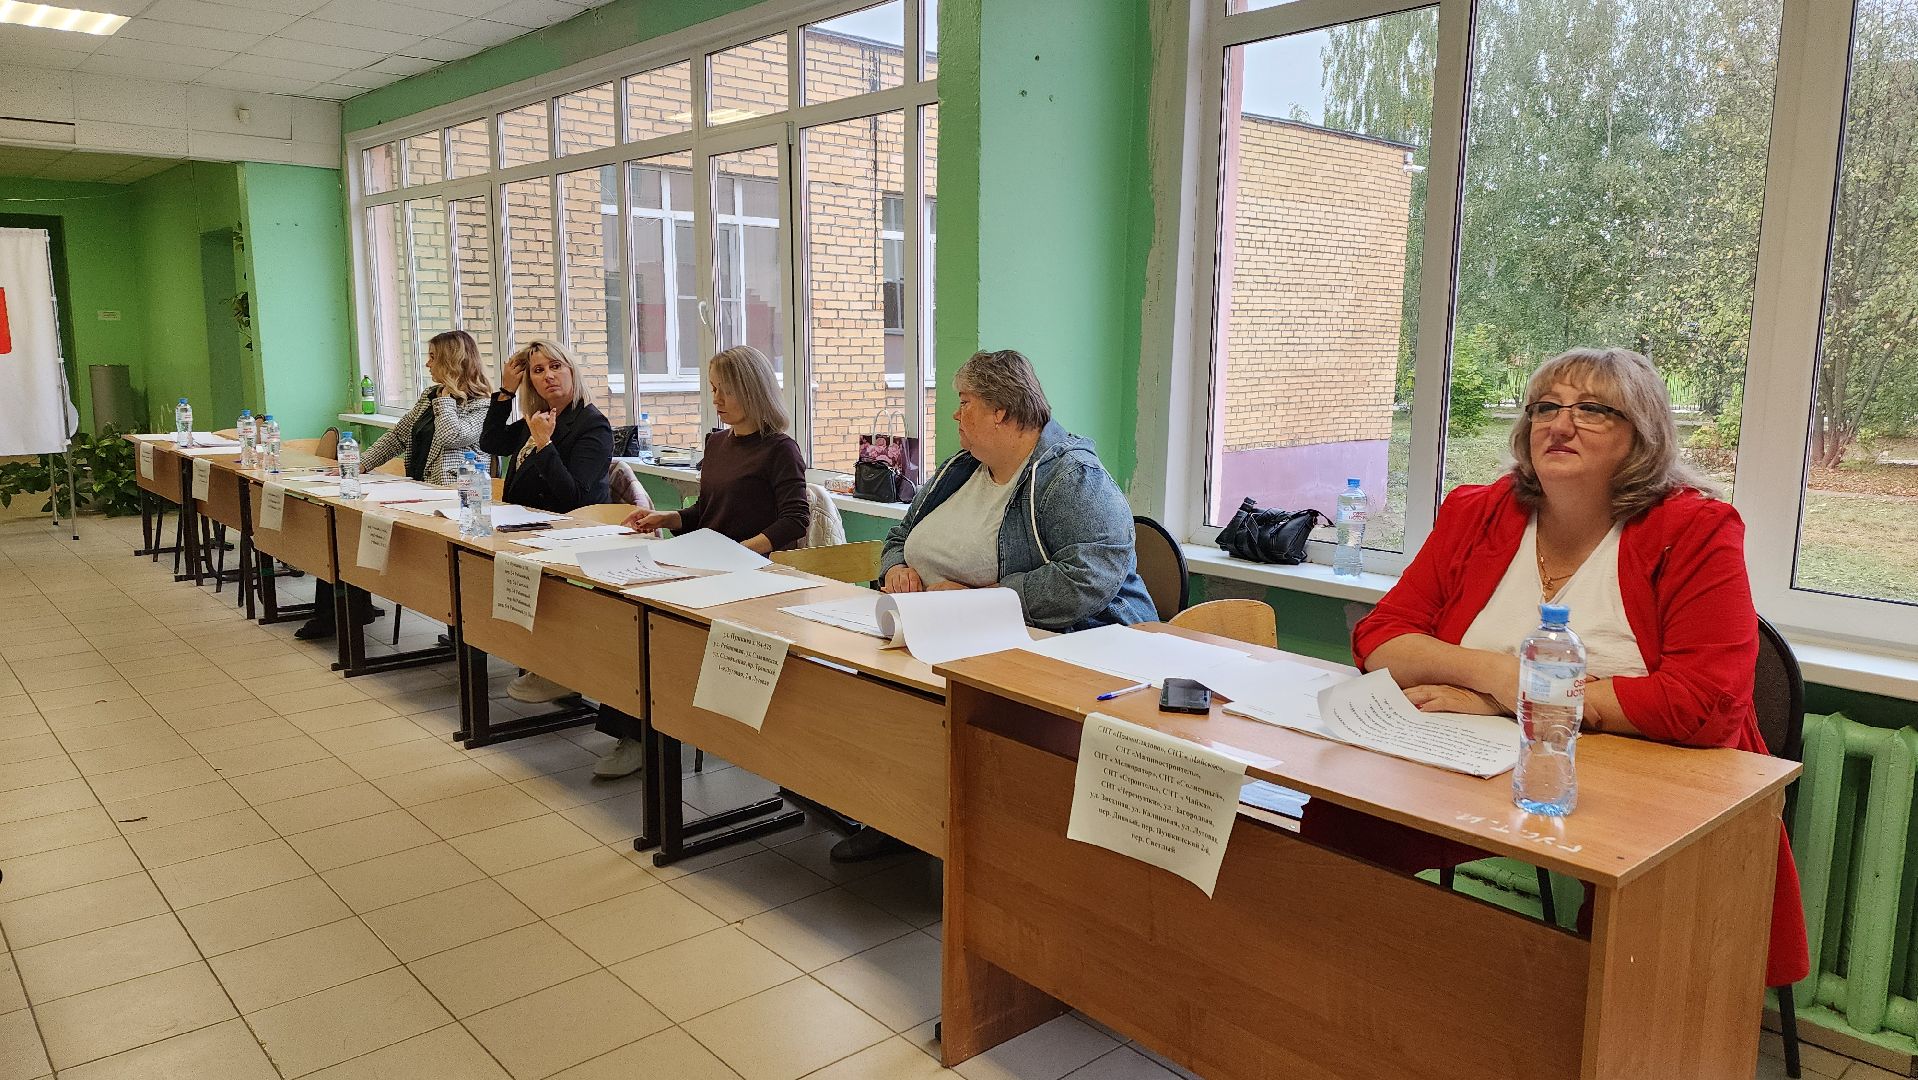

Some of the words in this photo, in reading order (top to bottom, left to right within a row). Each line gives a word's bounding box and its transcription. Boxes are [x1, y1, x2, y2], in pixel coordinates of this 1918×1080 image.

[1093, 750, 1108, 761] СНТ
[1158, 773, 1174, 784] СНТ
[1103, 767, 1118, 778] СНТ
[1101, 780, 1116, 791] СНТ
